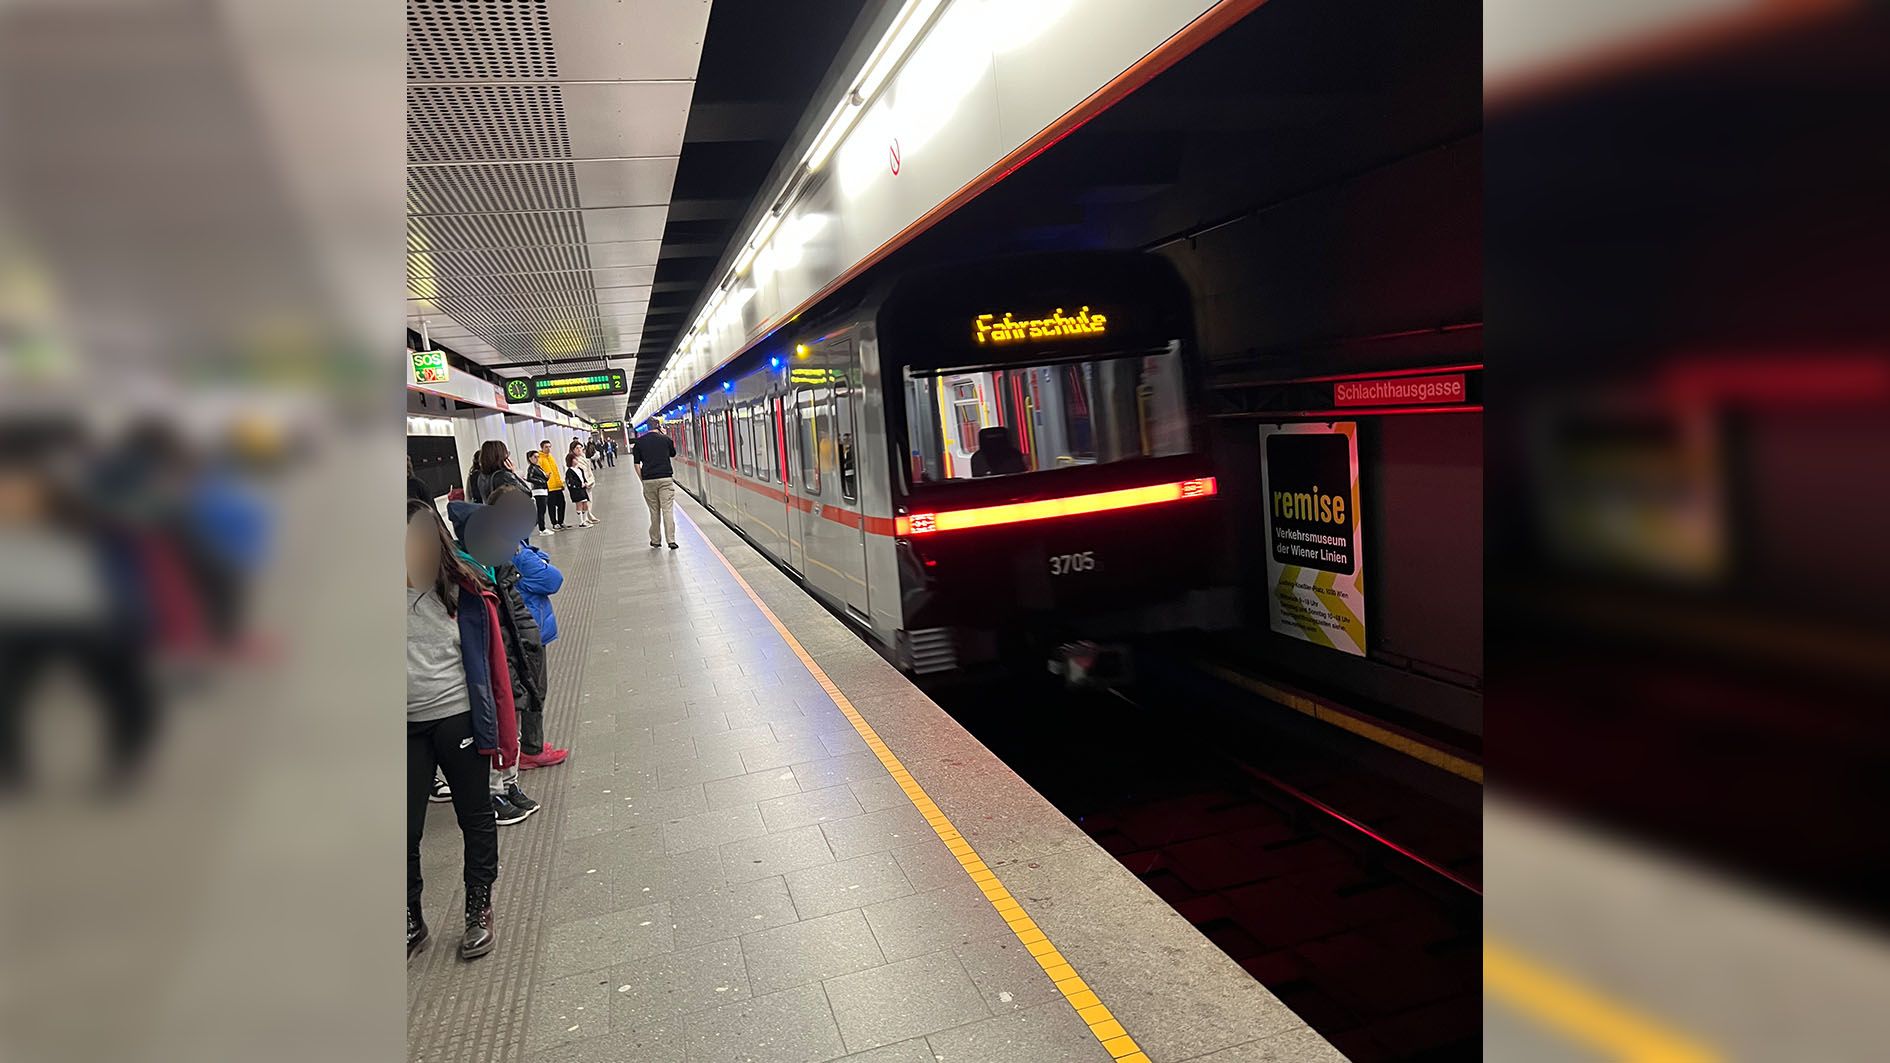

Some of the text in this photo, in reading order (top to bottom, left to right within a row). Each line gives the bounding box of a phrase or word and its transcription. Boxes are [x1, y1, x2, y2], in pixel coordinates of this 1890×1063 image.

[976, 306, 1106, 342] Fahrschule
[414, 354, 442, 366] SOS
[1337, 381, 1461, 401] Schlachthausgasse
[1274, 485, 1345, 525] remise
[1276, 527, 1347, 548] Verkehrsmuseum
[1050, 551, 1095, 575] 3705
[1277, 542, 1348, 564] der Wiener Linien
